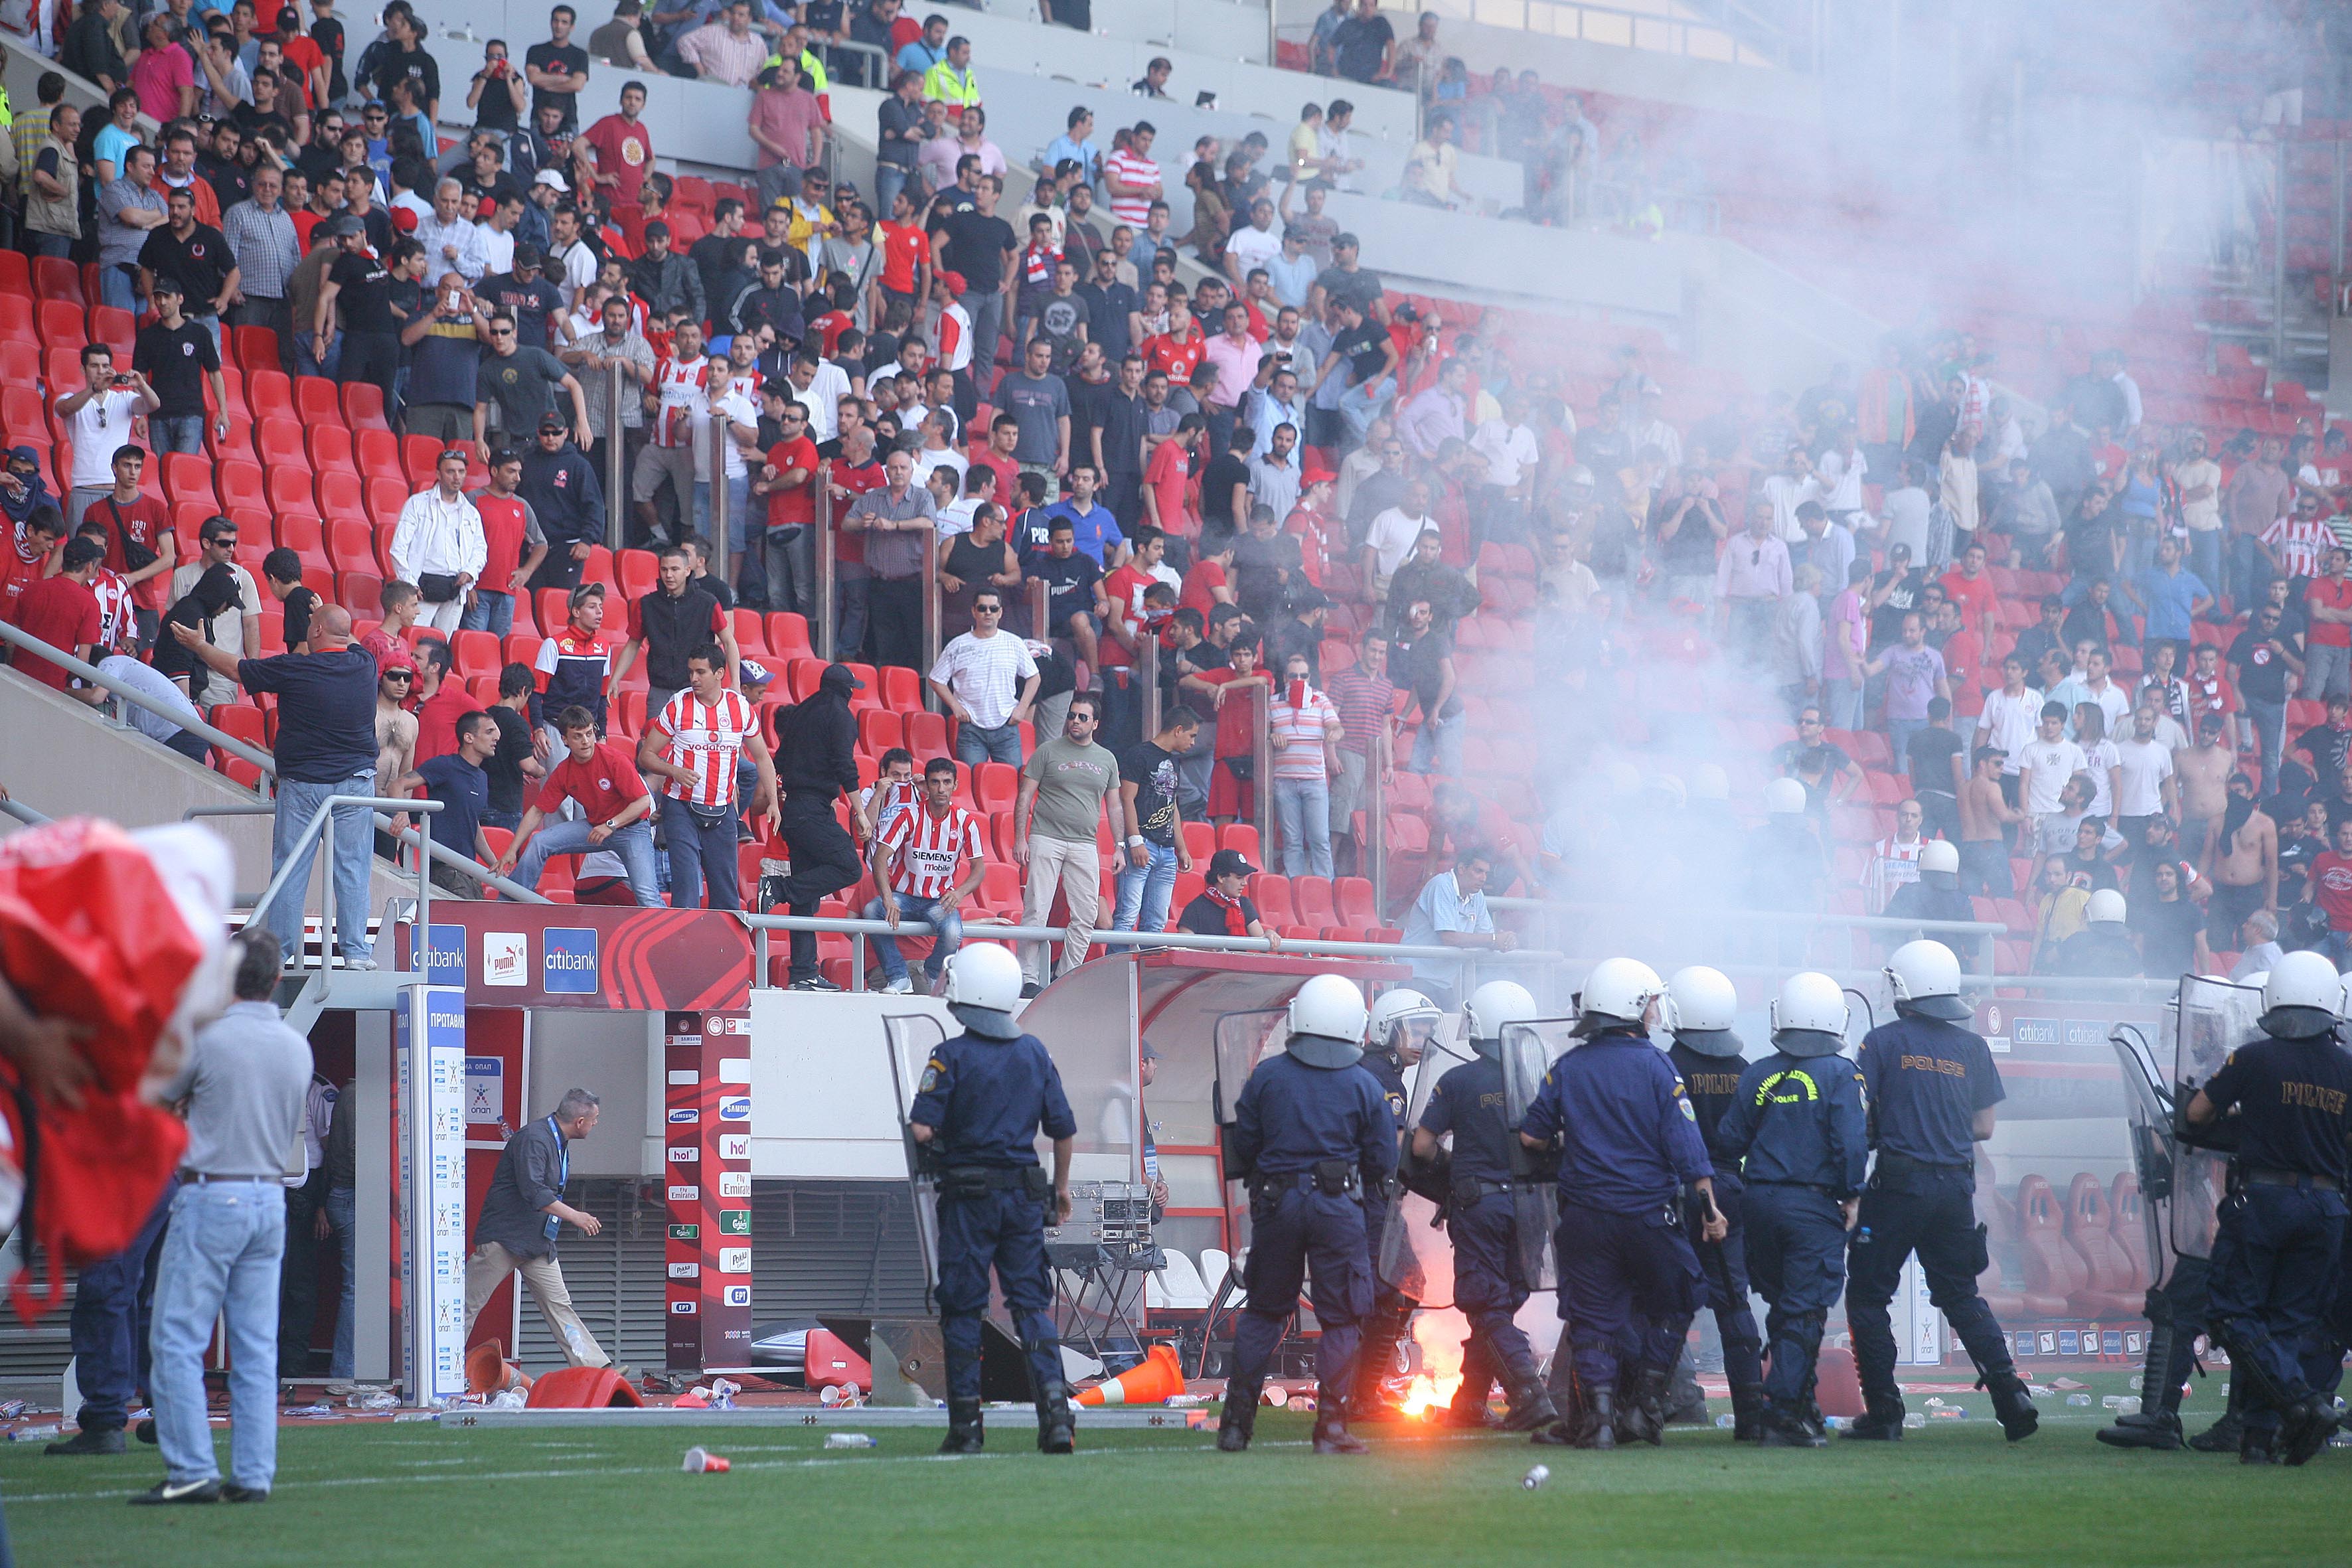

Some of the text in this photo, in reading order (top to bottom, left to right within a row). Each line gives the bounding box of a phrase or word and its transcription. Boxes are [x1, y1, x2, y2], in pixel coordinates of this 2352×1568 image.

[131, 520, 146, 530] 1981
[912, 850, 953, 862] SIEMENS
[924, 863, 950, 872] mobile
[413, 947, 463, 968] cibank
[495, 957, 514, 971] PUMA
[546, 949, 595, 971] citibank
[2019, 1024, 2055, 1042] citibank
[2069, 1026, 2104, 1044] citibank
[1901, 1054, 1966, 1078] POLICE
[1691, 1073, 1741, 1095] POLIC
[674, 1150, 690, 1160] hol
[730, 1140, 746, 1156] hol
[737, 1174, 745, 1184] Fly
[732, 1251, 747, 1265] Pokka
